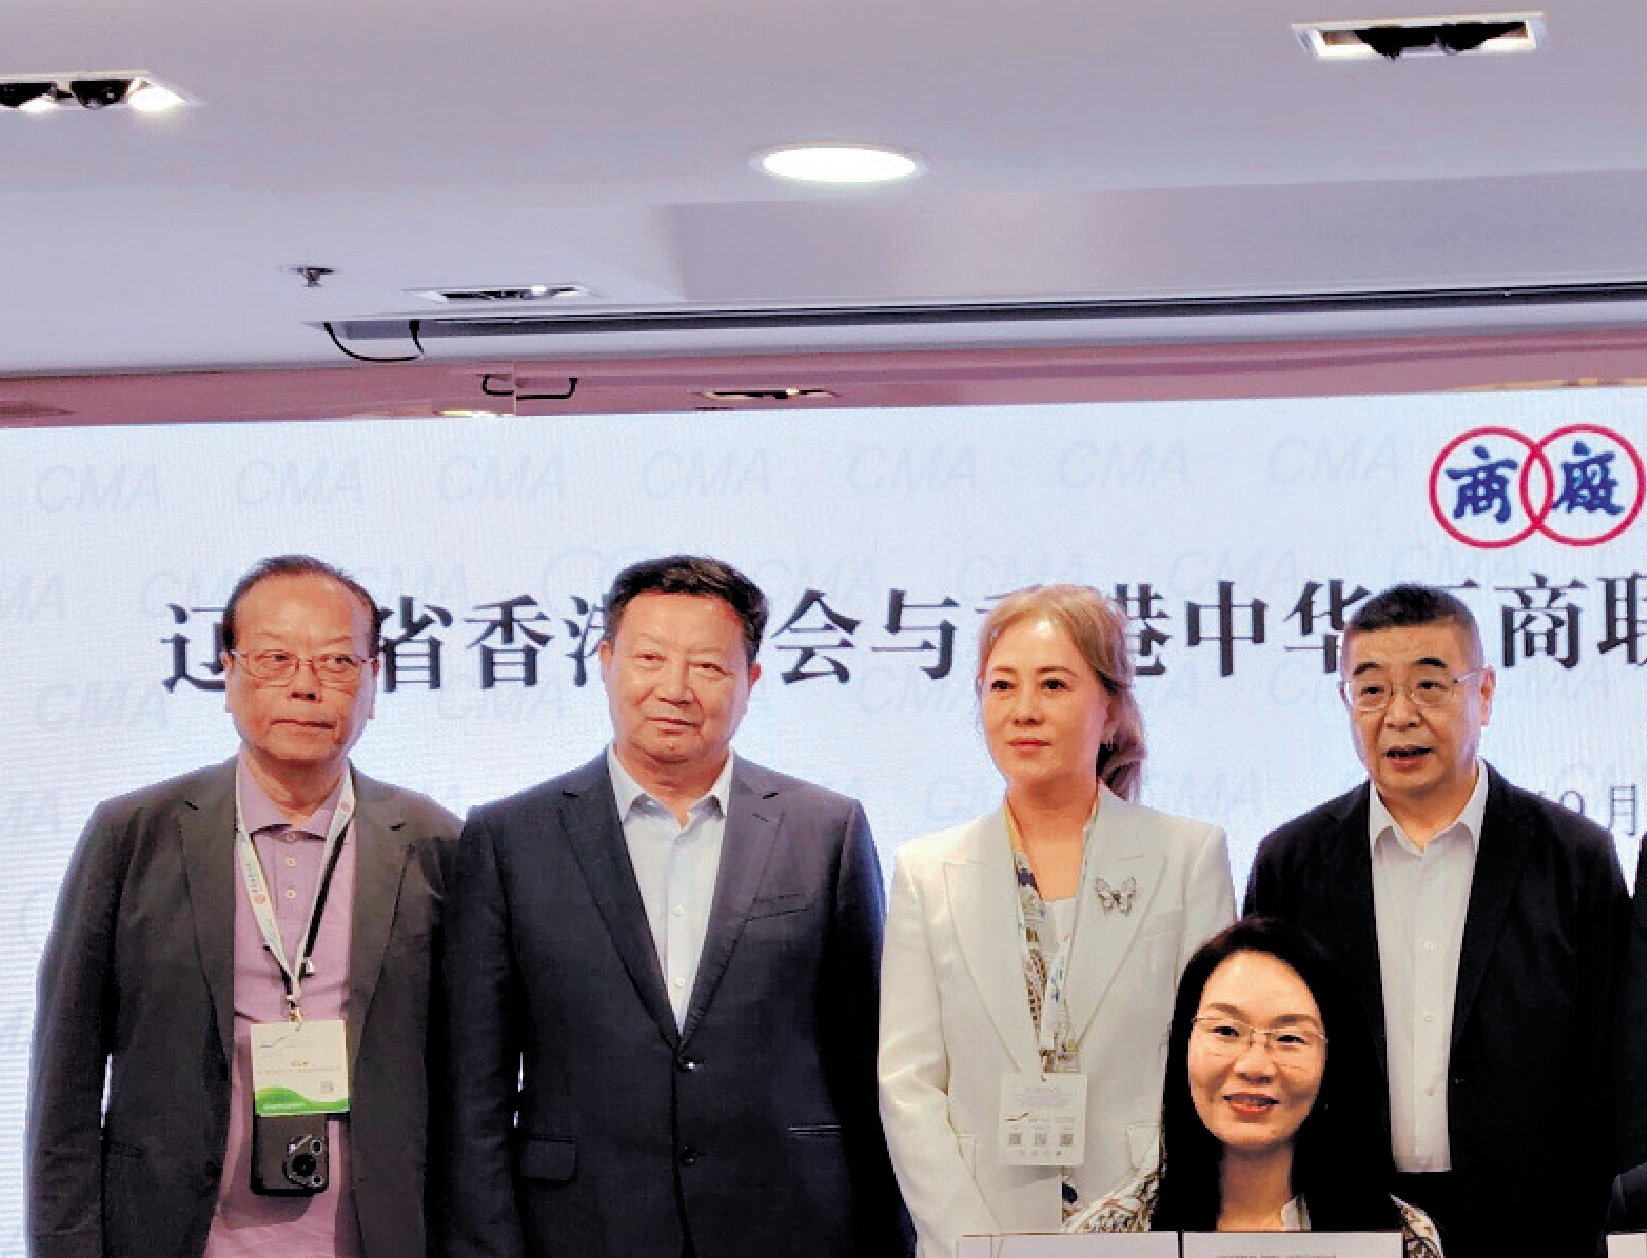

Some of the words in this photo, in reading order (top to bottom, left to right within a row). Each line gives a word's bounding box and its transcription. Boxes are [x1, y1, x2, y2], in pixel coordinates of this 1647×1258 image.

[233, 458, 364, 509] CMA
[435, 453, 568, 505] CMA
[640, 448, 773, 499] CMA
[846, 444, 980, 496] CMA
[1056, 439, 1190, 491] CMA
[1266, 433, 1400, 485] CMA
[34, 463, 165, 514] CMA
[34, 681, 170, 733] CMA
